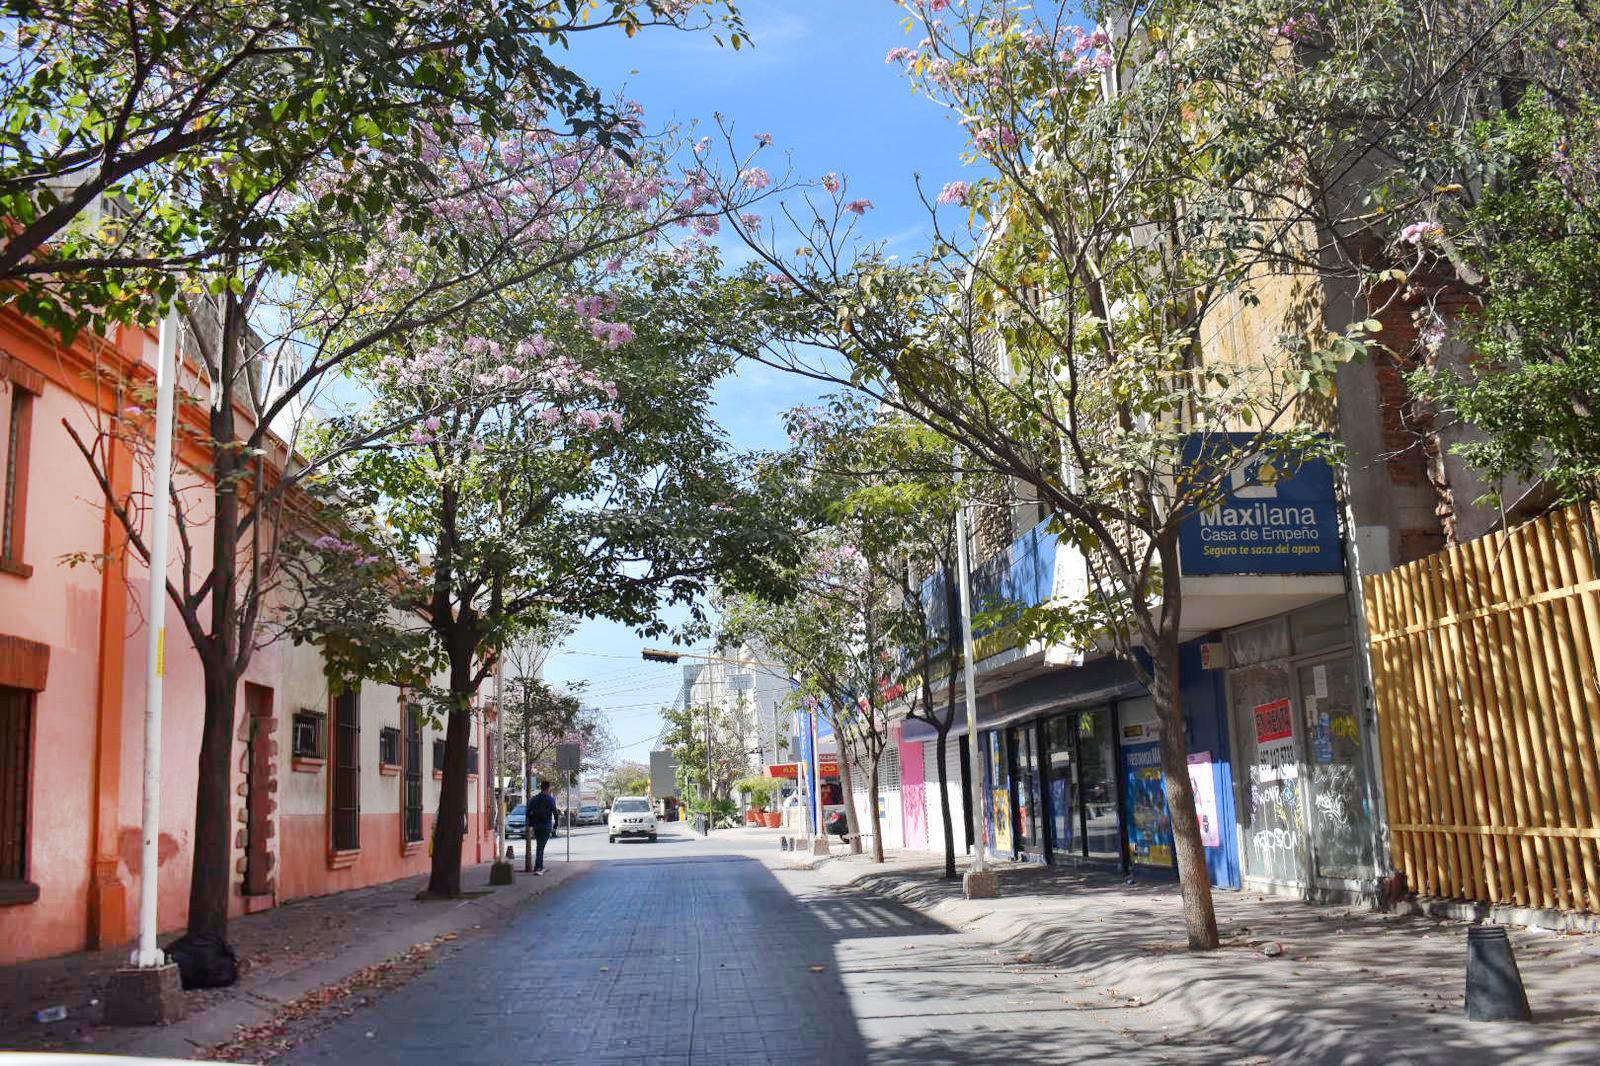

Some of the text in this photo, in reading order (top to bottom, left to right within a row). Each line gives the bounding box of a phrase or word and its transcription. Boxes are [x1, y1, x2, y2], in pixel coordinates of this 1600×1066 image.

[1200, 503, 1316, 526] Maxilana
[1200, 527, 1319, 543] Casa de Empeño
[1203, 544, 1320, 557] Seguro te saca del apuro
